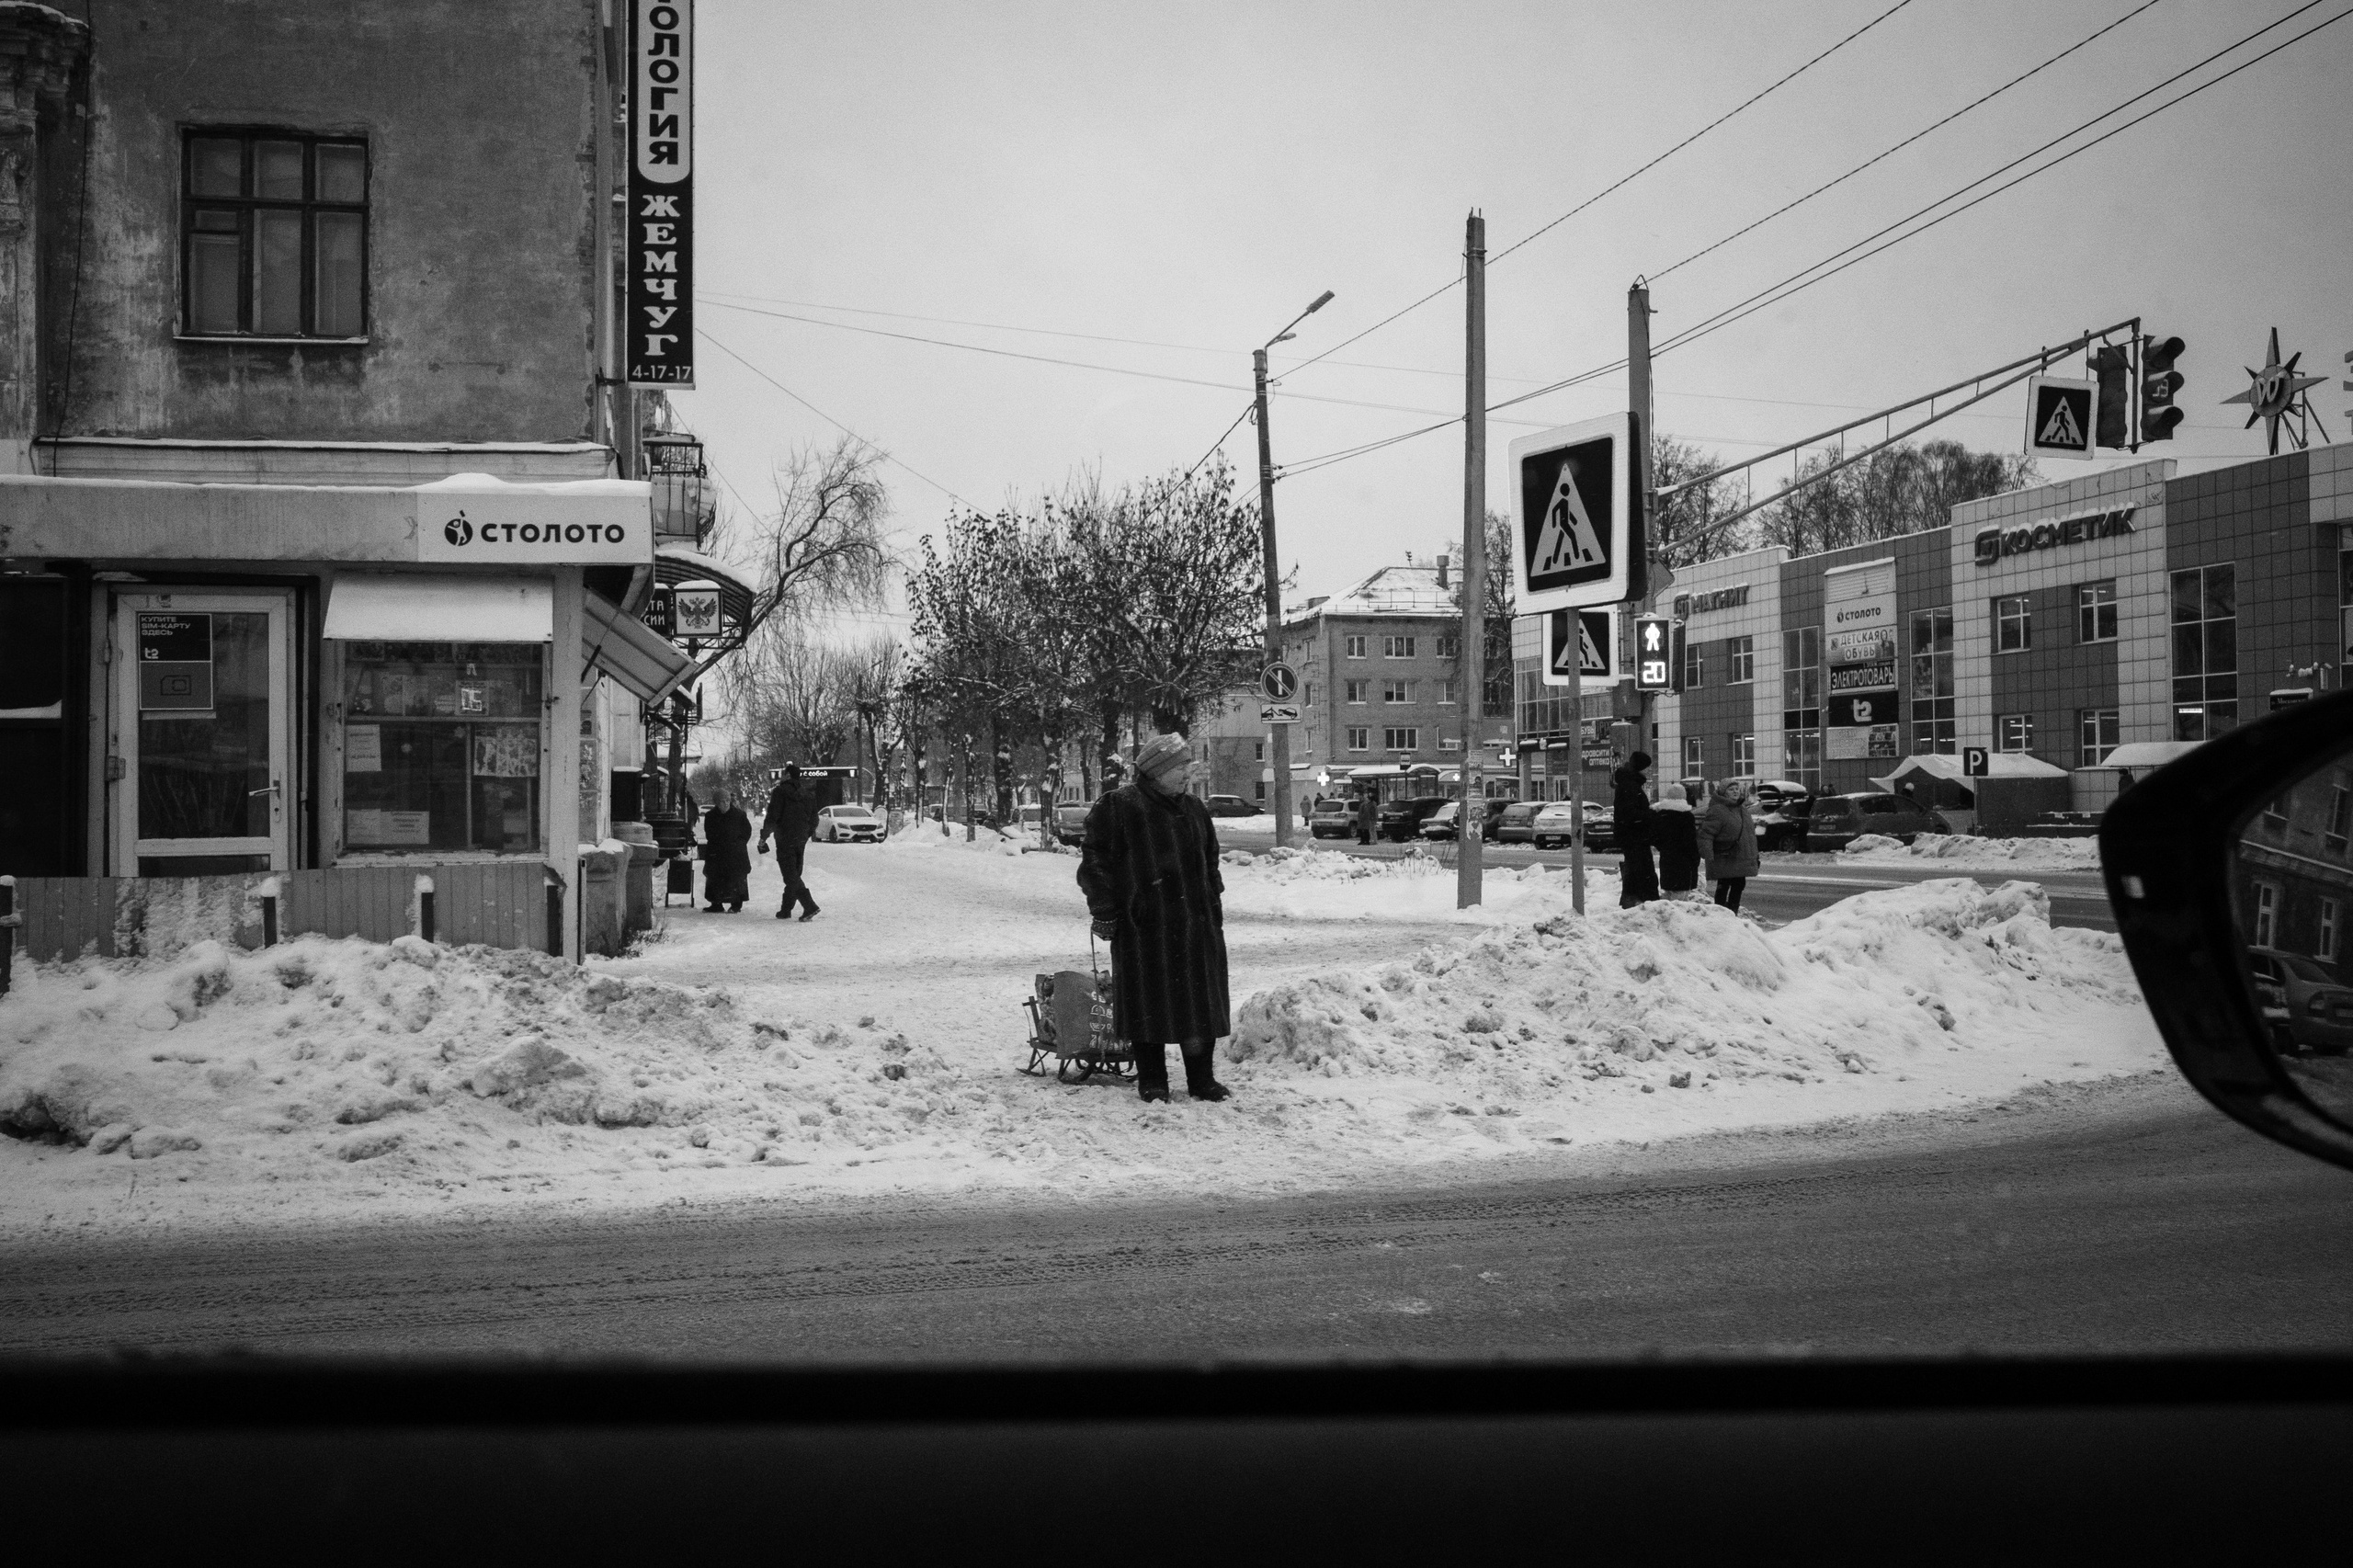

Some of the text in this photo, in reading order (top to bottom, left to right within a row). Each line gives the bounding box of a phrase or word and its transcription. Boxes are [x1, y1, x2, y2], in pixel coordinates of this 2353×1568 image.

[648, 0, 680, 165] ОЛОГИЯ
[641, 195, 680, 356] ЖЕМЧУГ
[632, 365, 692, 380] 4-17-17
[481, 523, 625, 543] СТОЛОТО
[2001, 506, 2136, 557] КОСМЕТИК
[650, 600, 665, 611] ТА
[643, 614, 665, 625] СИИ
[1845, 607, 1881, 620] СТОЛОТО
[1841, 631, 1880, 646] ДЕТСКАЯ
[1845, 646, 1875, 659] ОБУВЬ
[1643, 661, 1665, 683] 20
[1581, 749, 1609, 759] дравсити
[1588, 757, 1609, 767] аптека
[1969, 750, 1983, 775] P
